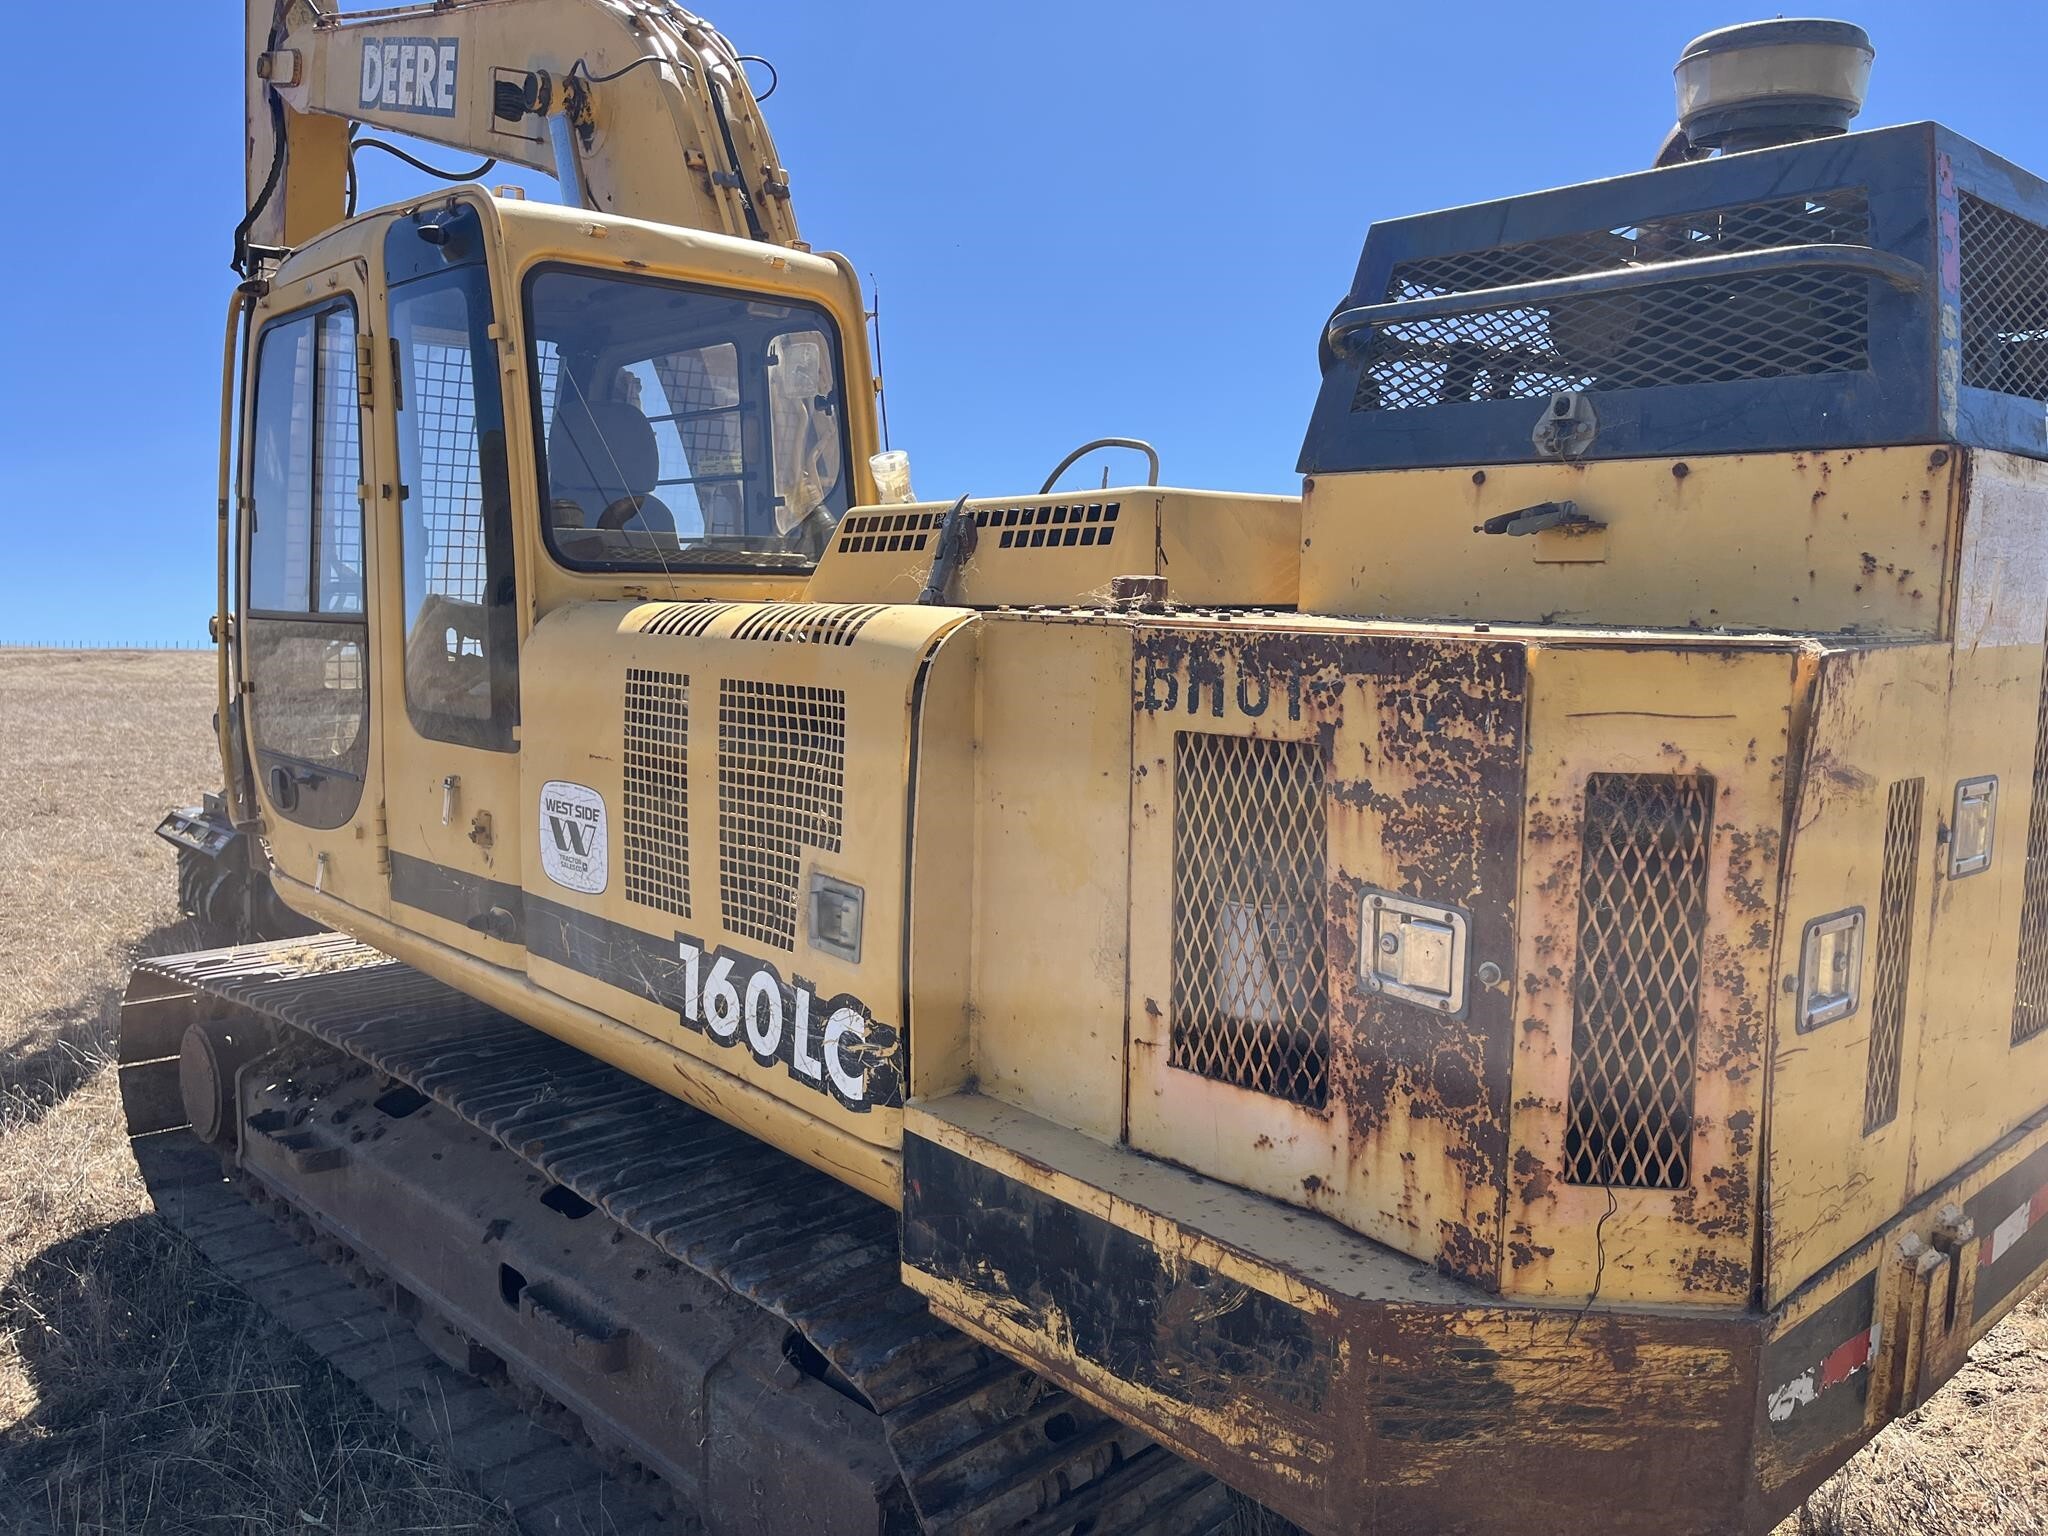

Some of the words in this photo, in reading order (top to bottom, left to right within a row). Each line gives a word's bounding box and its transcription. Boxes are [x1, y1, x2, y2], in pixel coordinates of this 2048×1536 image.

[360, 42, 457, 111] DEERE
[545, 797, 573, 817] WEST
[575, 804, 600, 823] SIDE
[548, 815, 597, 857] W
